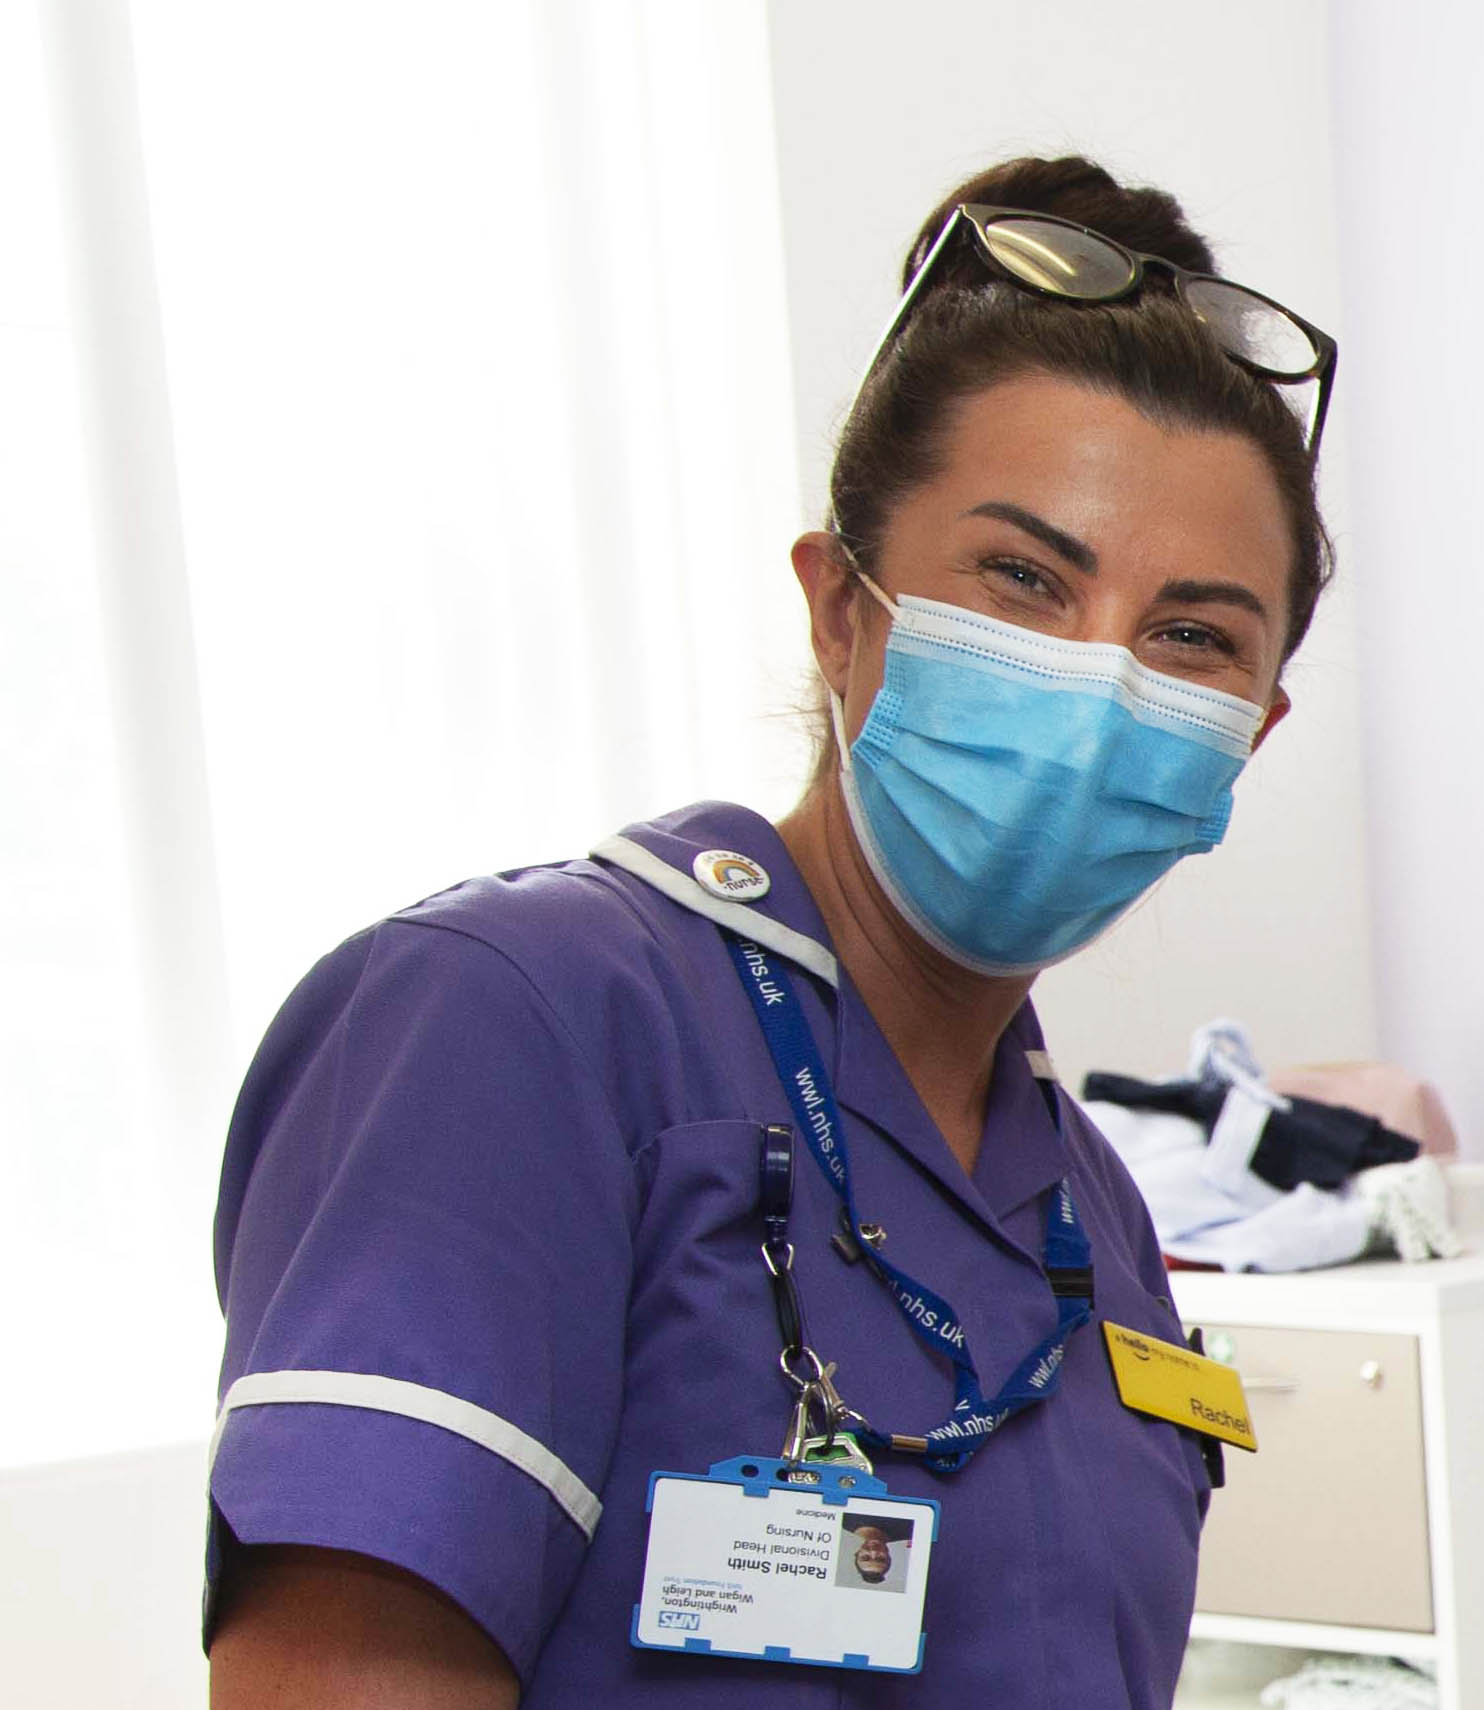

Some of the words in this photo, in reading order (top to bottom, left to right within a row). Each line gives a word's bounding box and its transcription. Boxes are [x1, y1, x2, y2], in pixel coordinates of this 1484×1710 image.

[794, 1067, 846, 1185] wwl.nhs.uk
[1191, 1398, 1251, 1435] Rachel
[795, 1508, 836, 1521] Medicine
[765, 1524, 814, 1541] Nursing
[816, 1532, 832, 1543] Of
[733, 1540, 766, 1554] Head
[769, 1543, 830, 1561] Divisional
[727, 1557, 771, 1573] Smith
[775, 1562, 827, 1580] Rachel
[661, 1585, 693, 1598] Leigh
[695, 1588, 717, 1599] and
[719, 1590, 754, 1604] Wigan
[659, 1611, 699, 1631] NHS
